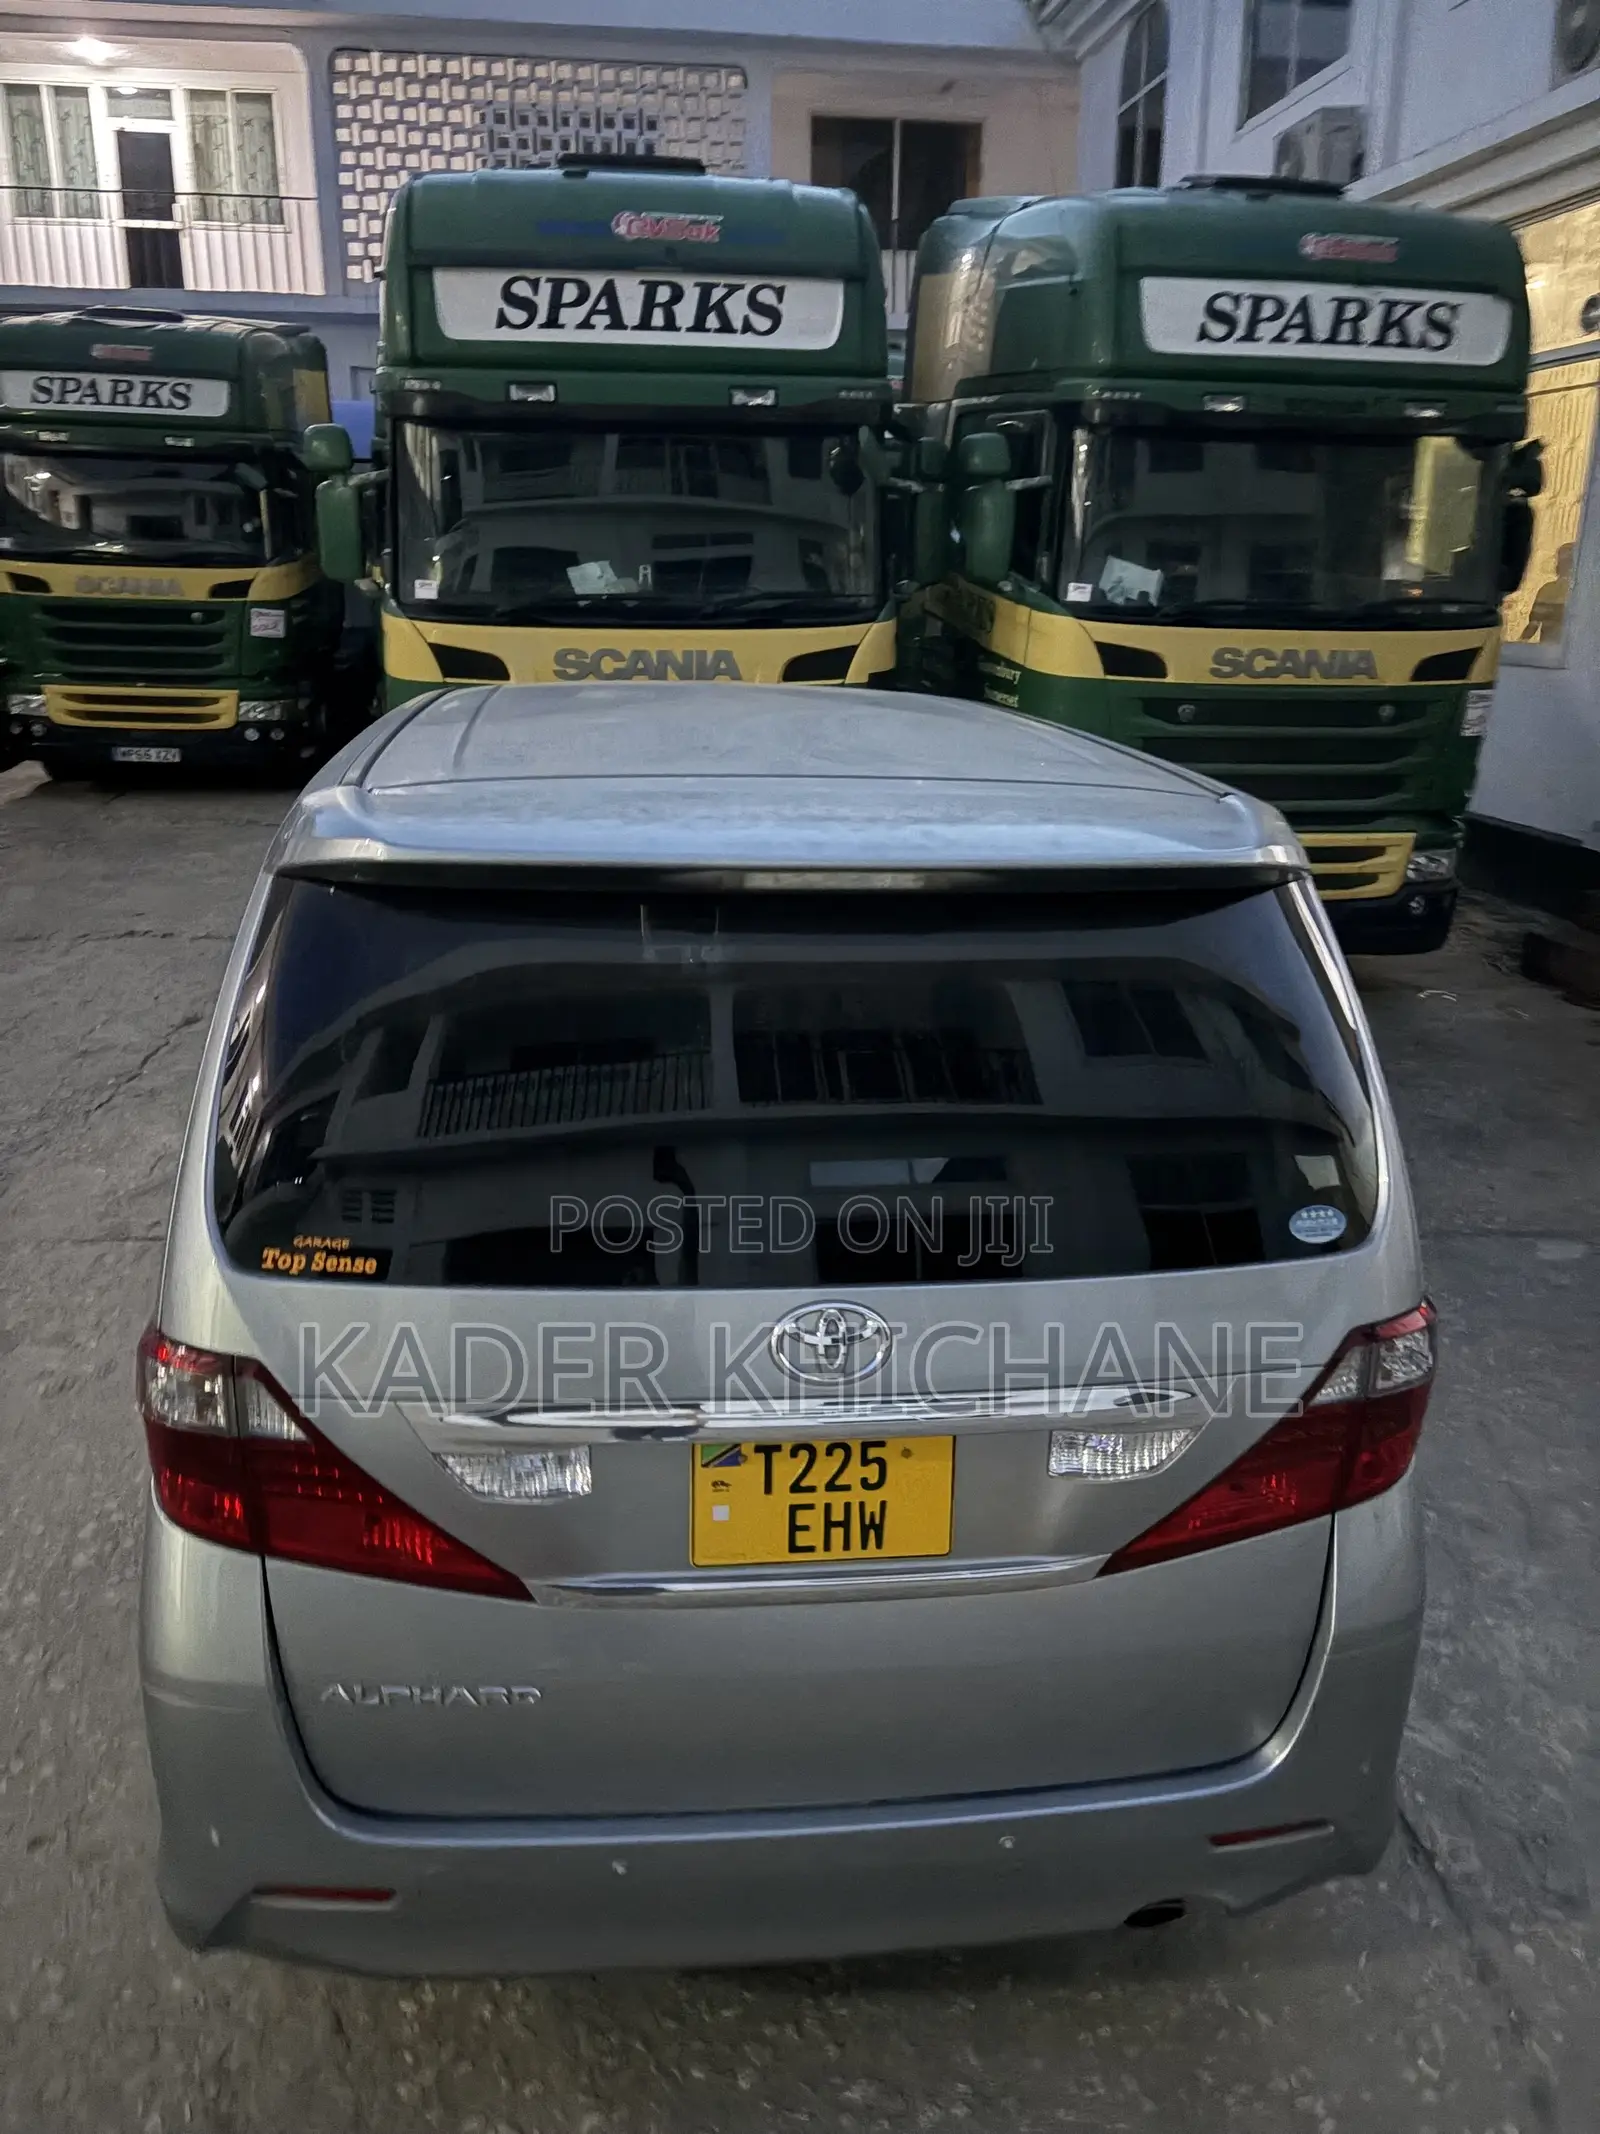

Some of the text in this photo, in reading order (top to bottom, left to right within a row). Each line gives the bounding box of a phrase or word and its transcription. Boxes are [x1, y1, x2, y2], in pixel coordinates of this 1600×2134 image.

[496, 275, 786, 337] SPARKS
[1196, 290, 1464, 352] SPARKS
[30, 375, 194, 411] SPARKS
[552, 647, 742, 681] SCANIA
[1208, 646, 1379, 679] SCANIA
[292, 1234, 351, 1251] GARAGE
[261, 1247, 378, 1275] Top Sense
[753, 1440, 888, 1496] T225
[787, 1499, 887, 1554] EHW
[320, 1682, 542, 1707] ALPHARD
